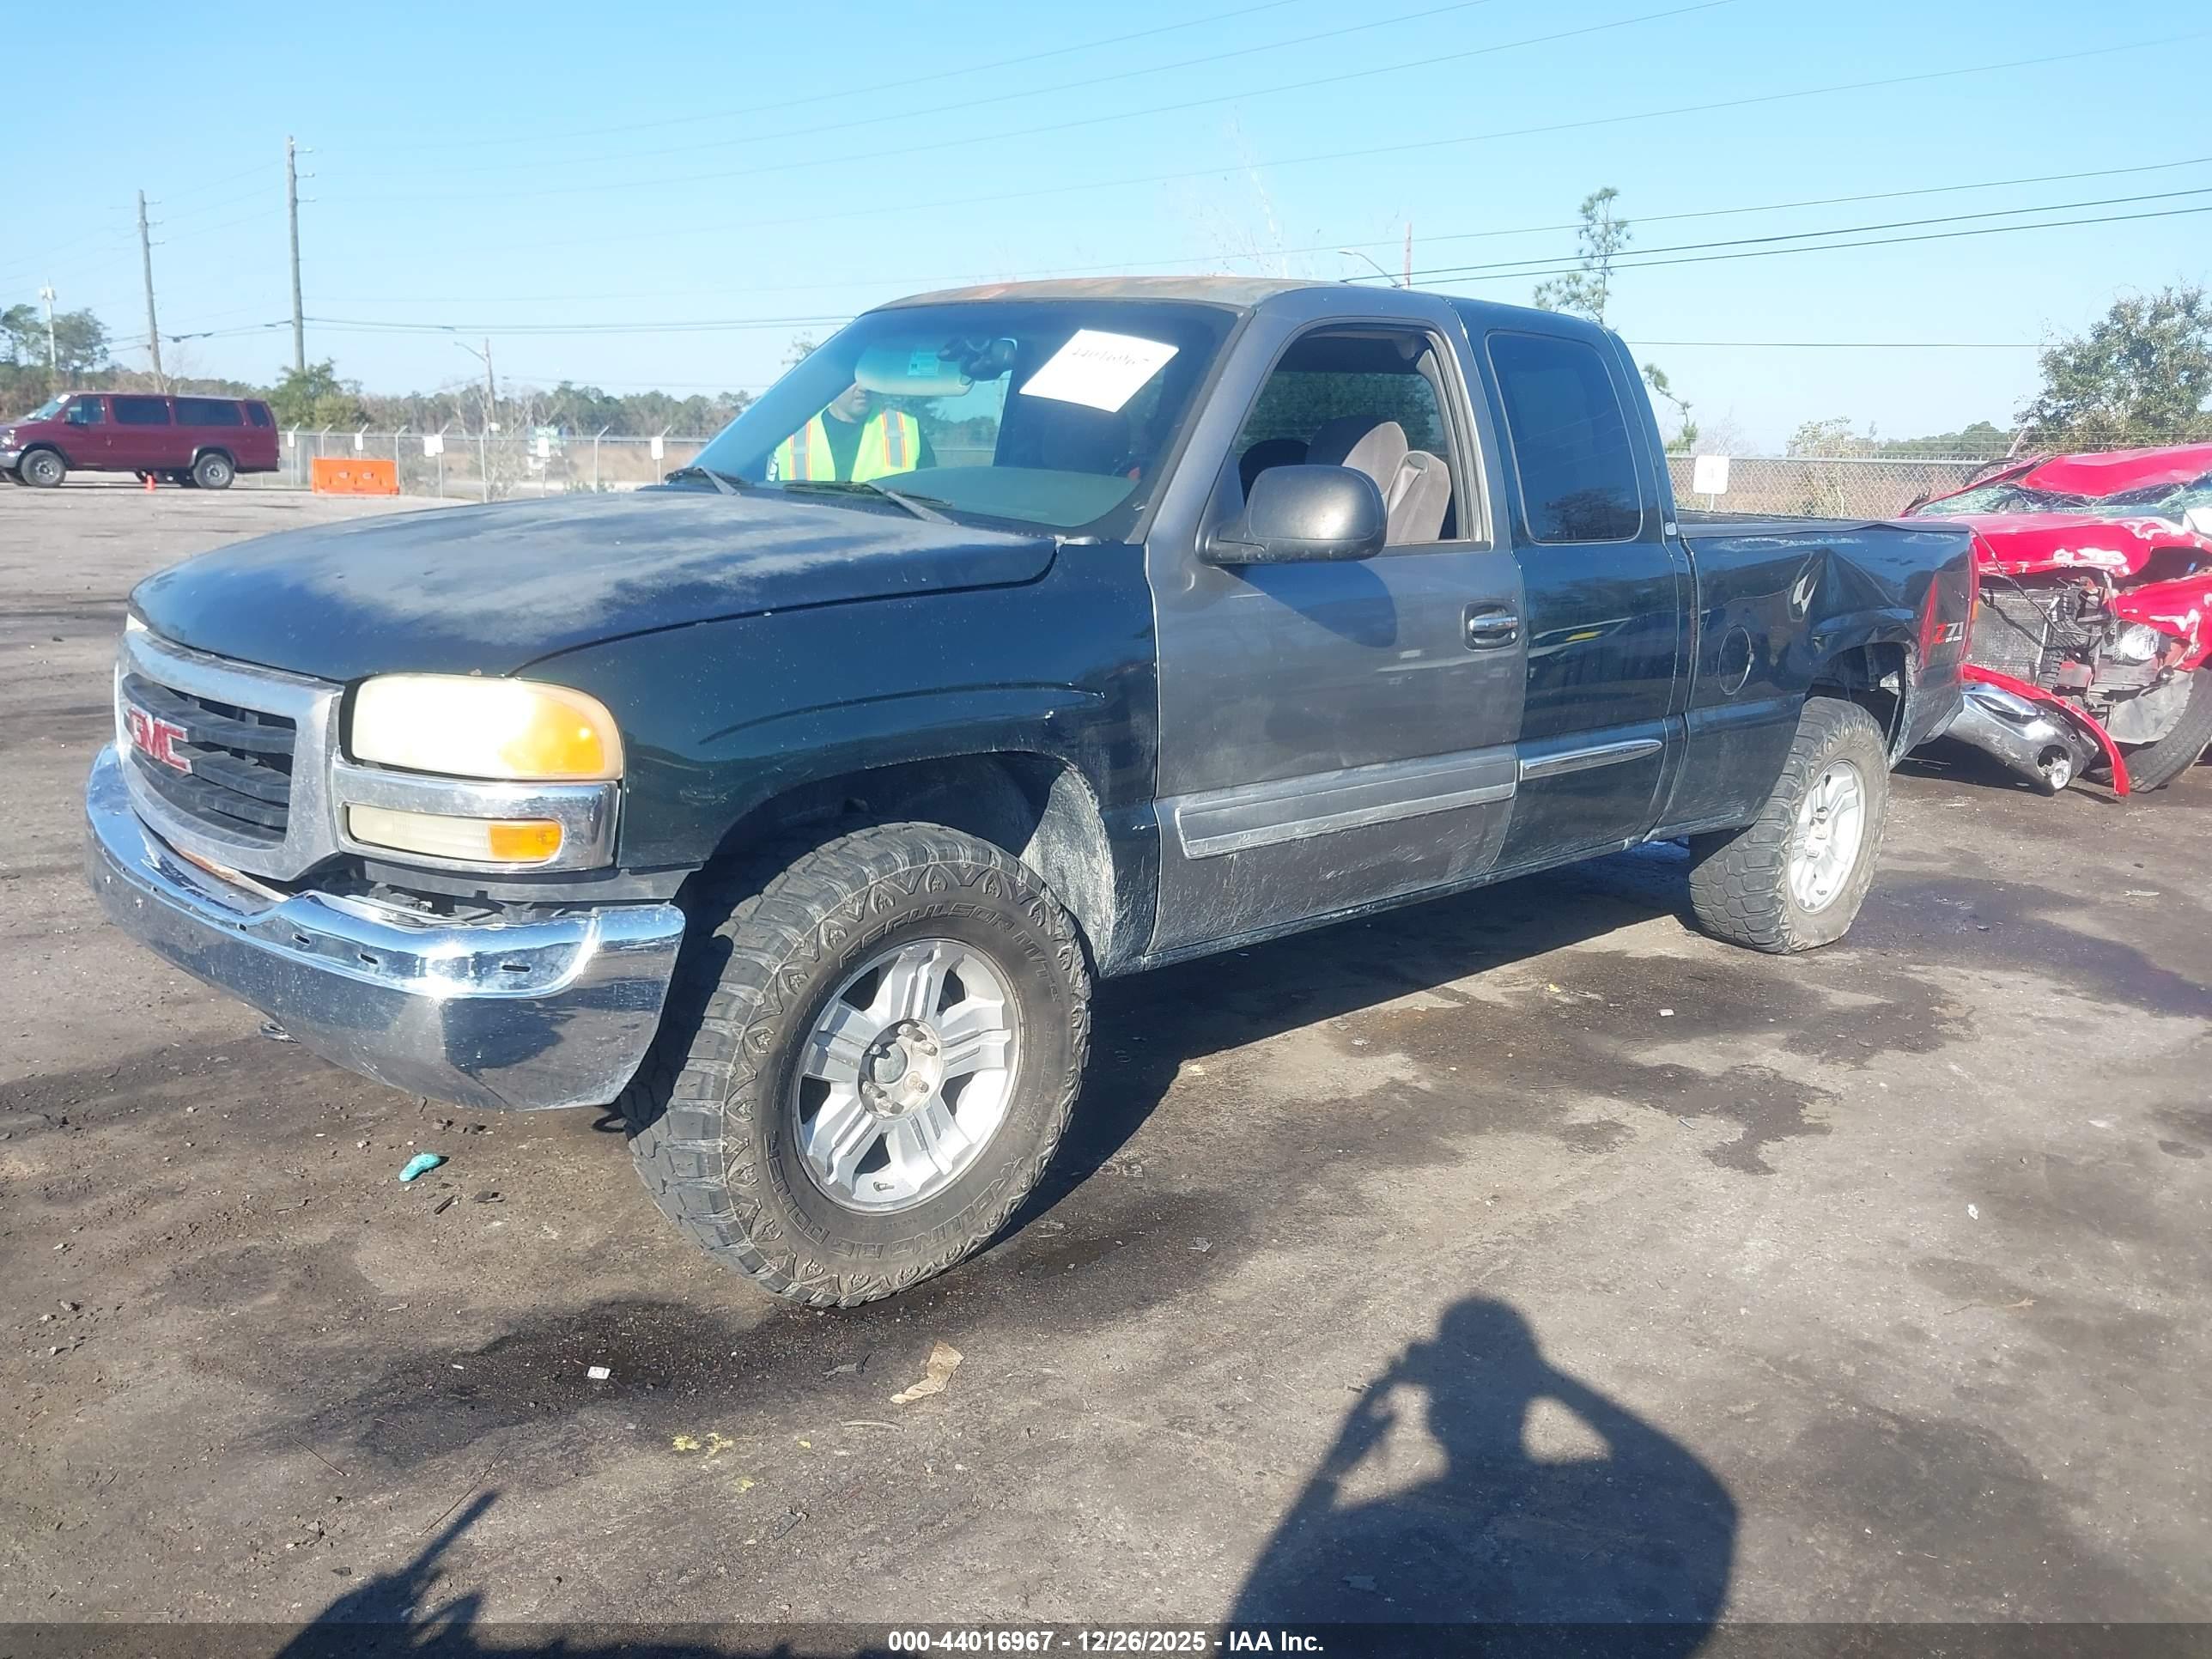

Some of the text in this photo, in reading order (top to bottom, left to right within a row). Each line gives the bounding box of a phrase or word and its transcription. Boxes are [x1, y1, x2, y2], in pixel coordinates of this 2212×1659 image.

[1934, 622, 1964, 644] Z71
[128, 703, 193, 775] GMC
[839, 902, 1016, 969] REPULSOR
[763, 1129, 831, 1246] POWER
